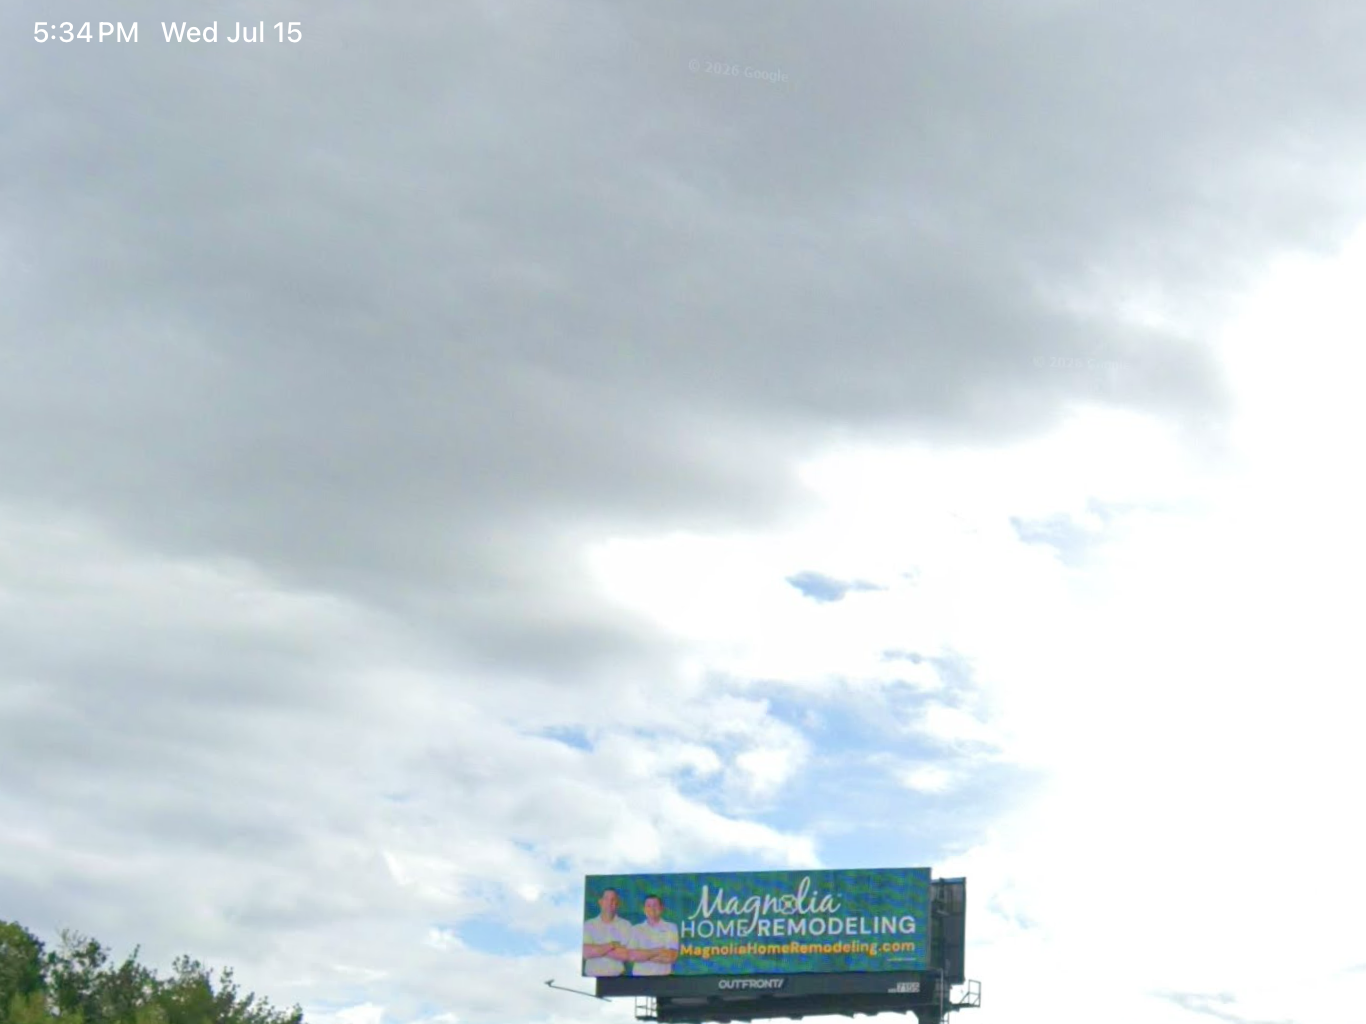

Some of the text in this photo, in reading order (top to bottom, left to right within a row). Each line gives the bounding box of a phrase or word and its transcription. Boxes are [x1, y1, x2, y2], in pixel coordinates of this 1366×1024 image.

[688, 875, 842, 934] Magnolia
[680, 915, 916, 938] HOME REMODELING
[680, 940, 915, 959] MagnoliaHomeRemodeling.com
